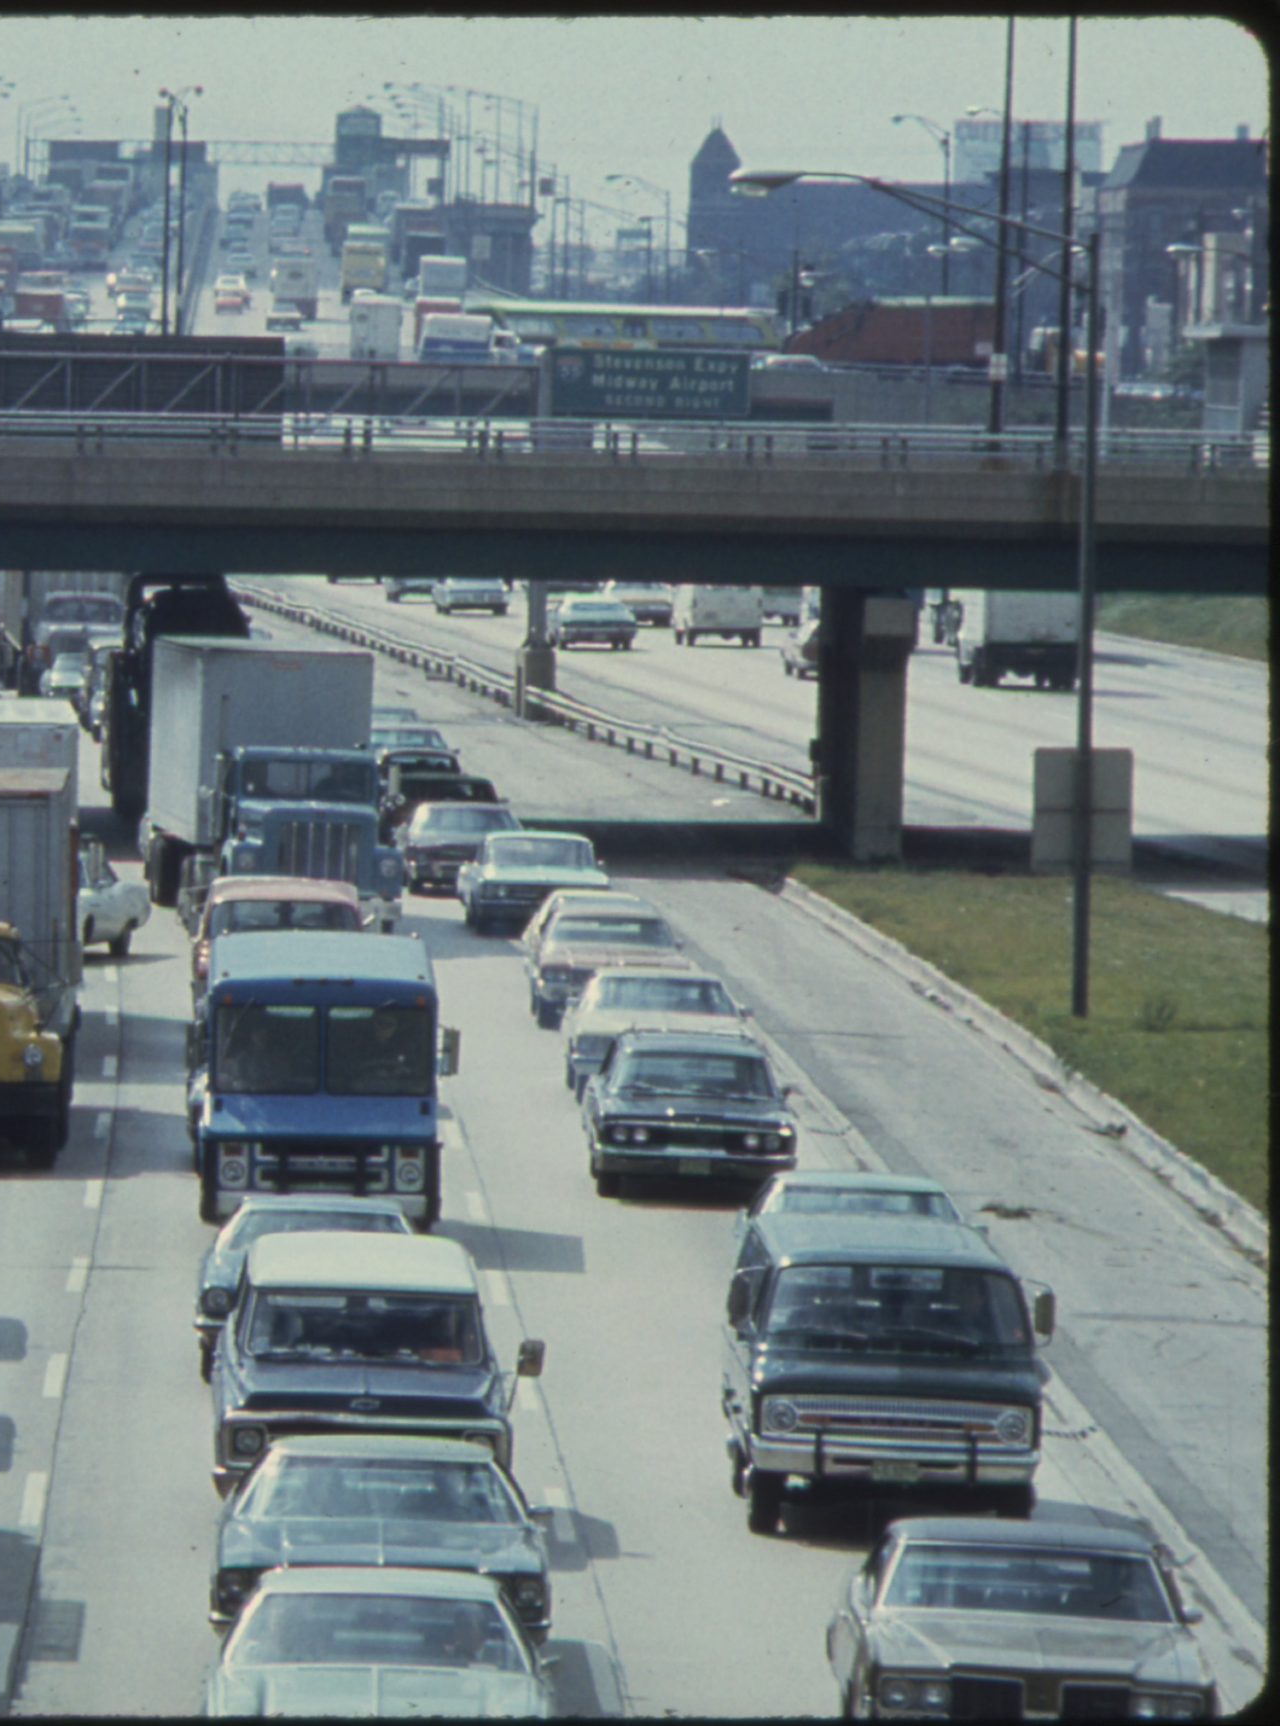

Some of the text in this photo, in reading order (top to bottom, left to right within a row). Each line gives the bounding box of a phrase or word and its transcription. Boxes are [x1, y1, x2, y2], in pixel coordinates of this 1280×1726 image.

[593, 353, 740, 375] Stevenson Expy
[592, 373, 735, 393] Midway Airport
[605, 394, 720, 409] SECOND RIGHT
